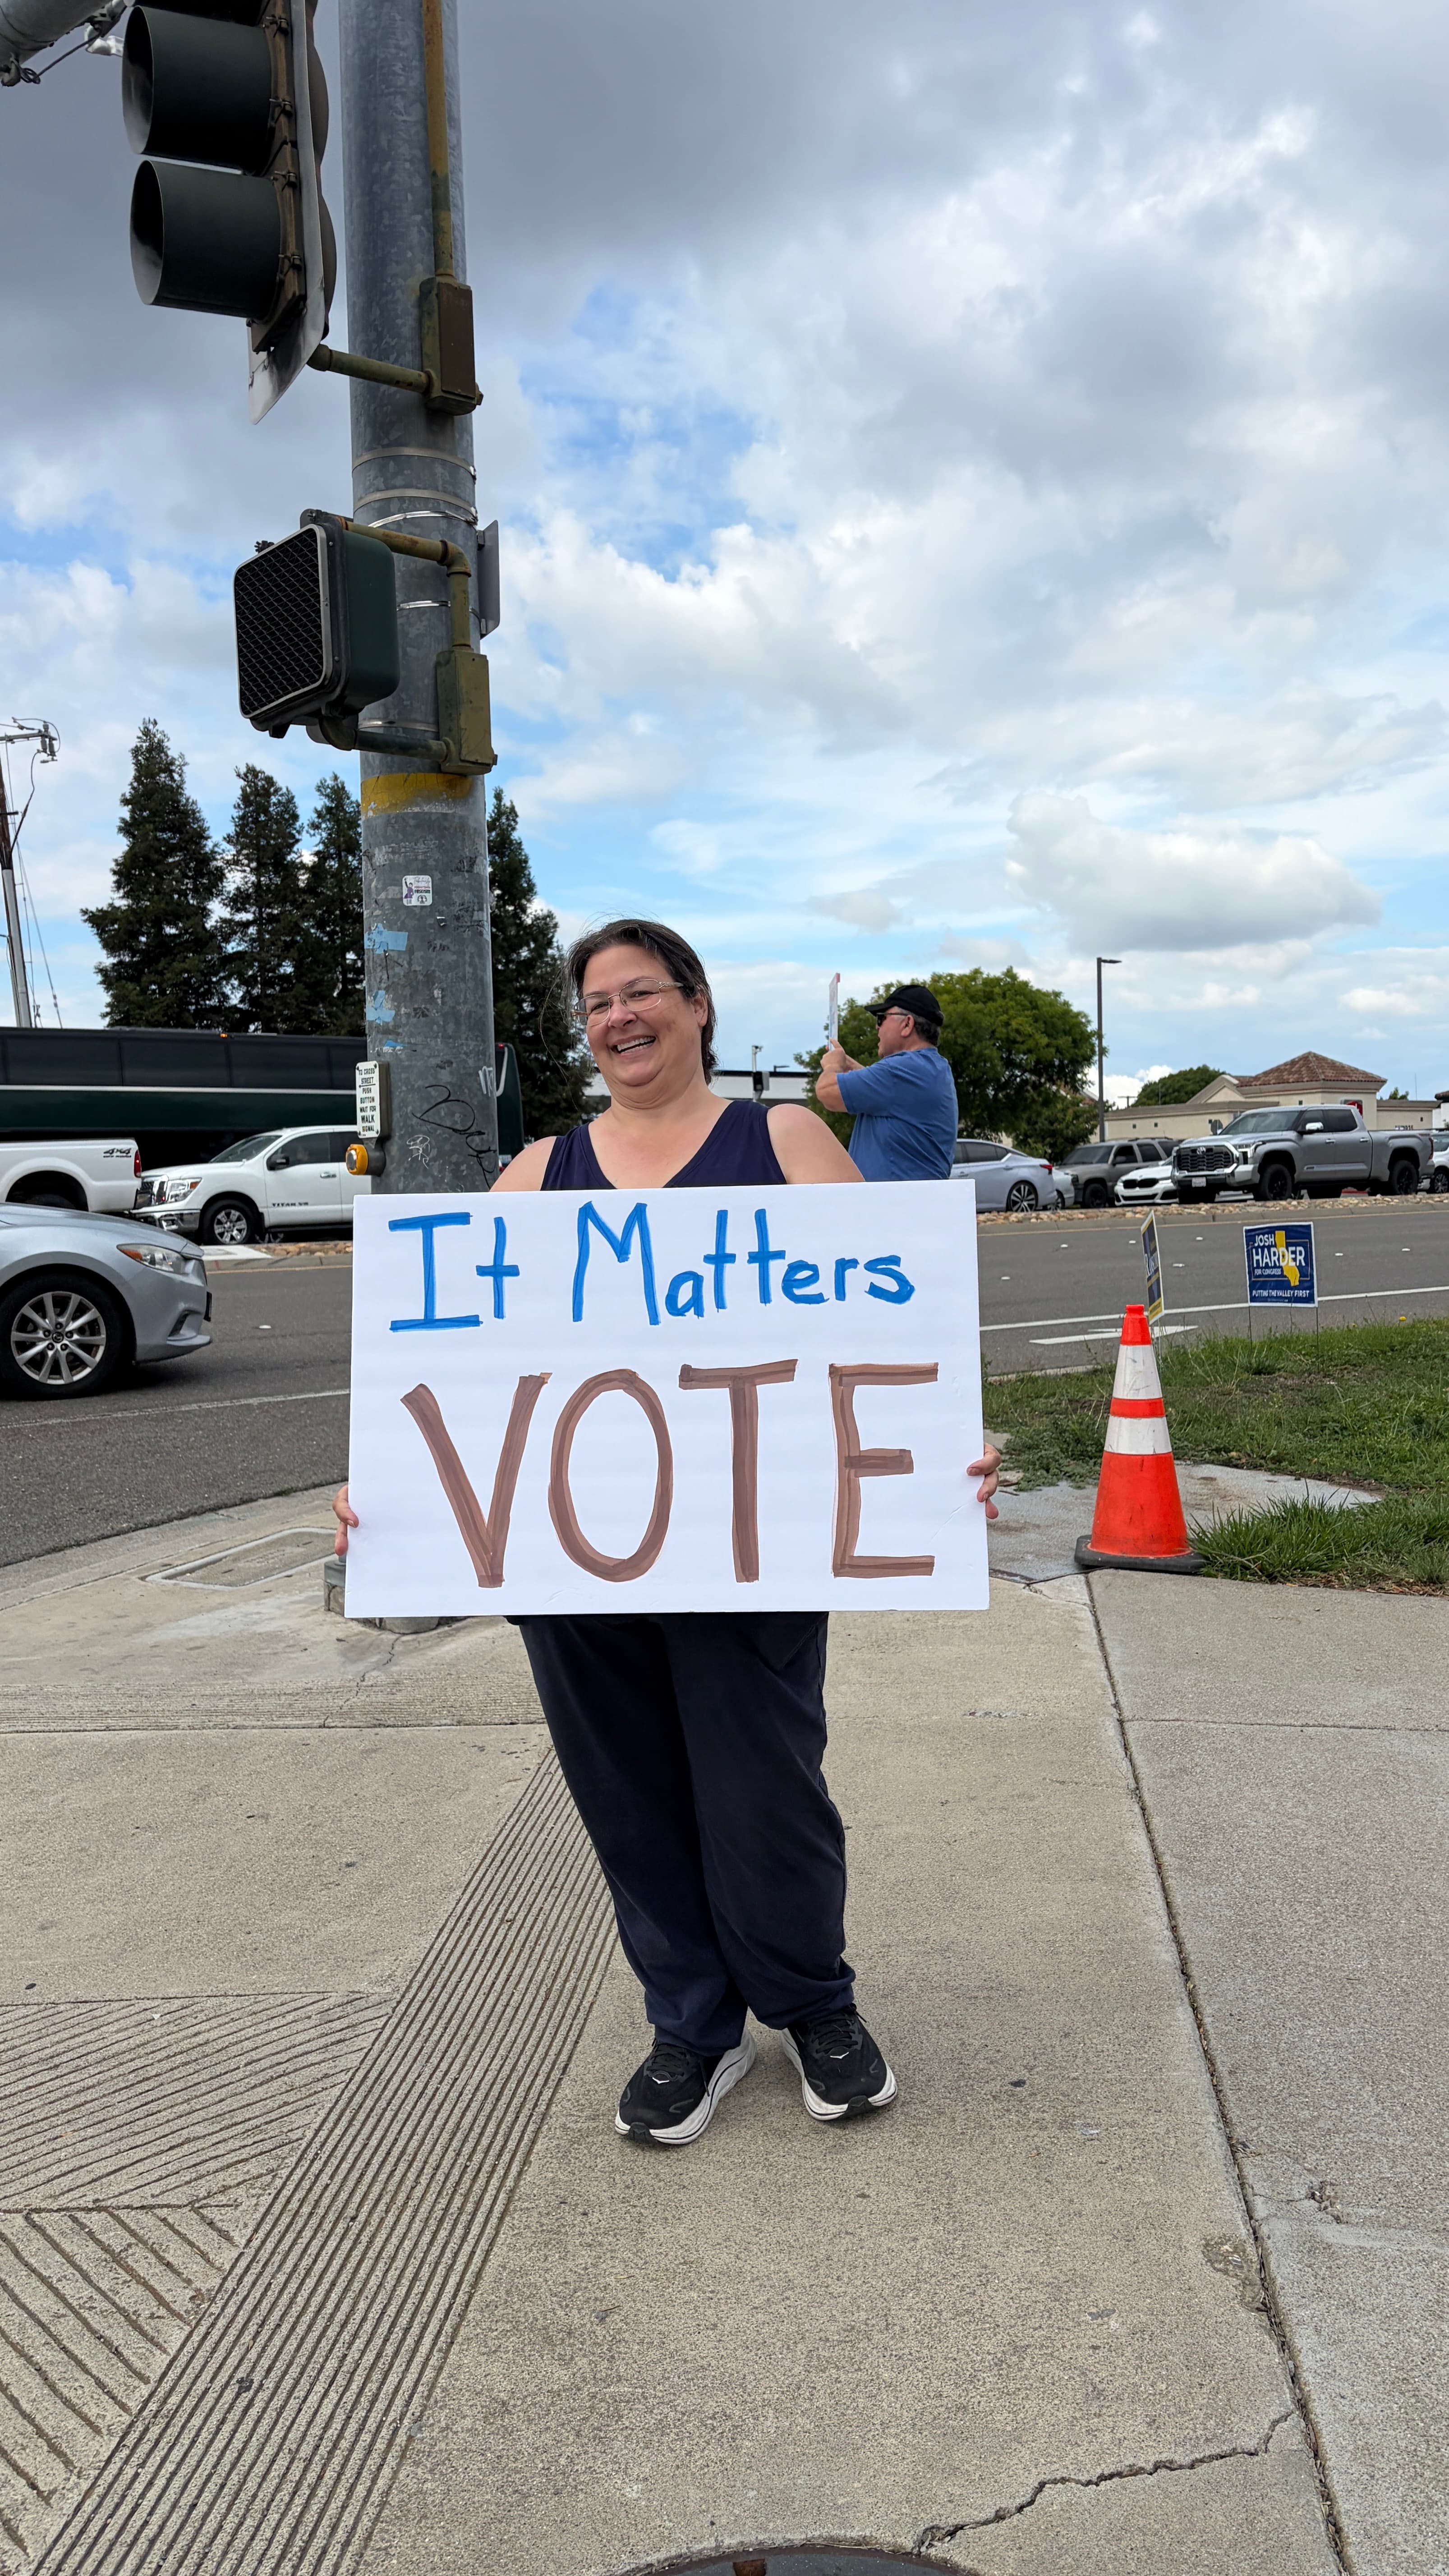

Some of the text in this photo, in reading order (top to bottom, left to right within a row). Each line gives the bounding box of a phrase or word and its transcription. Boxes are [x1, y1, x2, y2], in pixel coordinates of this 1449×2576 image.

[361, 1114, 375, 1124] WALK
[1254, 1233, 1274, 1247] JOSH
[388, 1201, 915, 1332] It Matters
[1252, 1246, 1306, 1267] HARDER
[400, 1358, 938, 1588] VOTE
